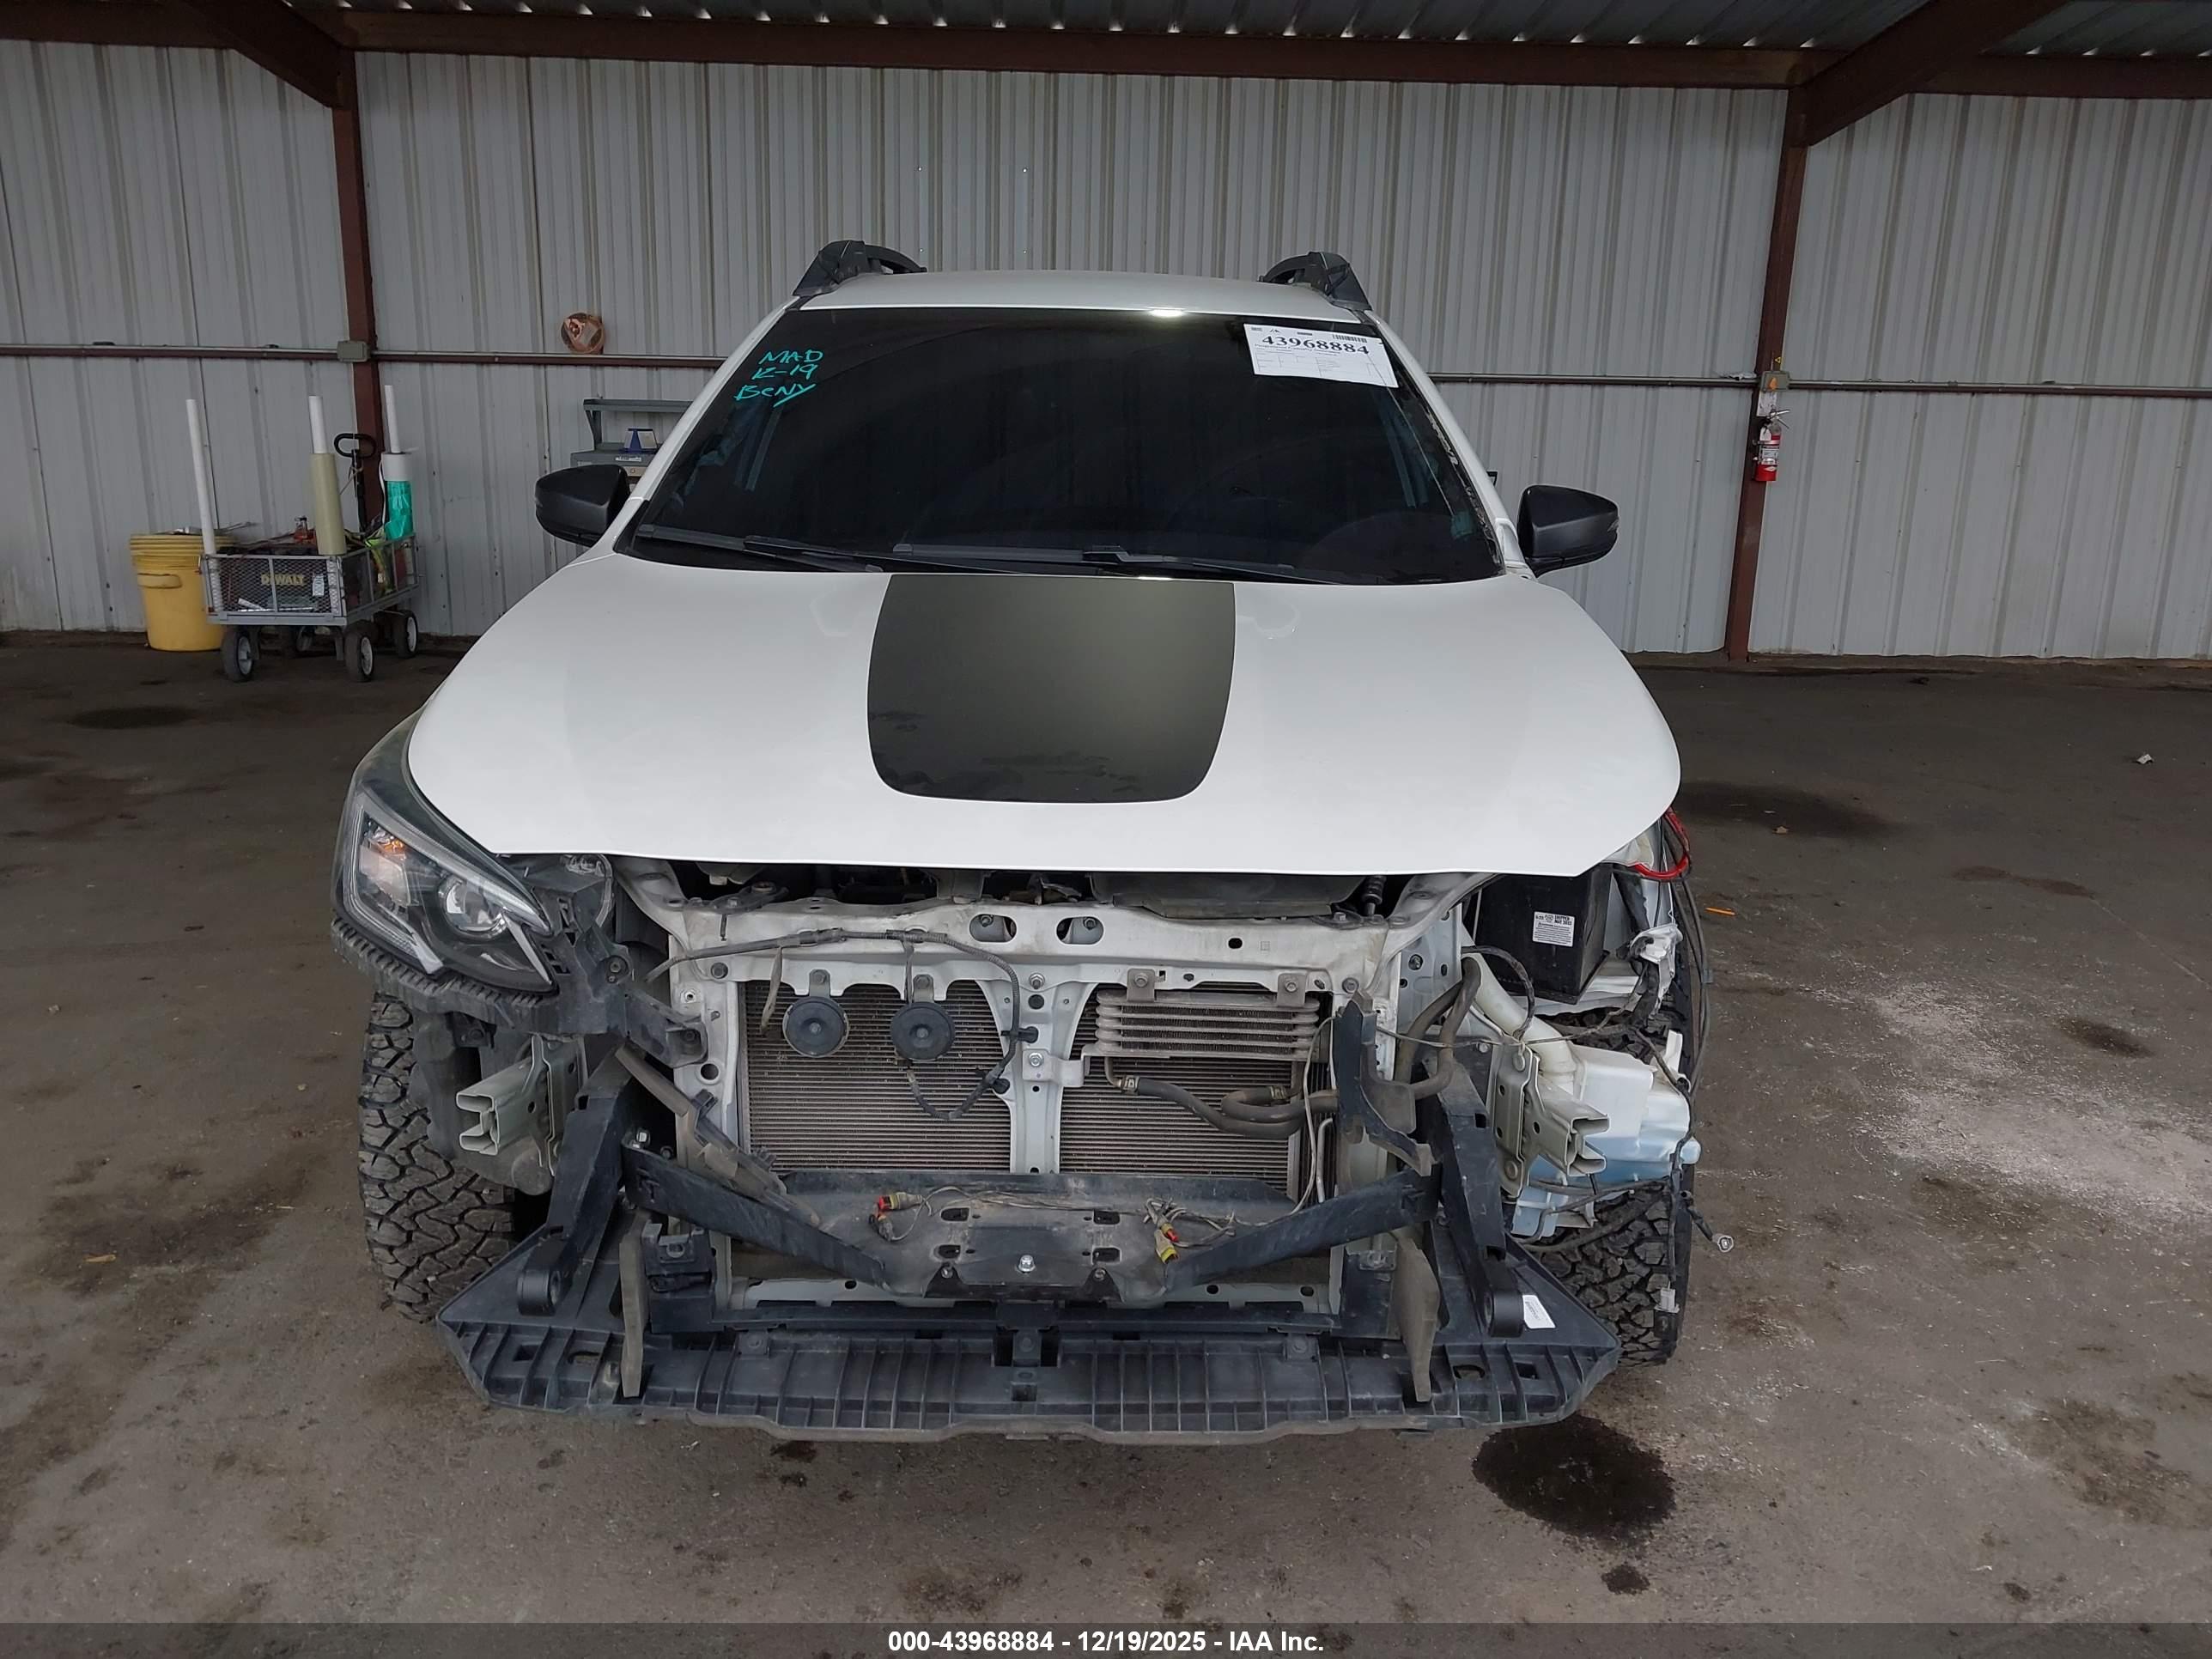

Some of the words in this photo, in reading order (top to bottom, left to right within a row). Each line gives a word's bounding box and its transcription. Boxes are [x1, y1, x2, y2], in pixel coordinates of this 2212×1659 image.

[1261, 335, 1370, 355] 43968884
[758, 349, 823, 364] MAD
[260, 573, 304, 585] DWALT
